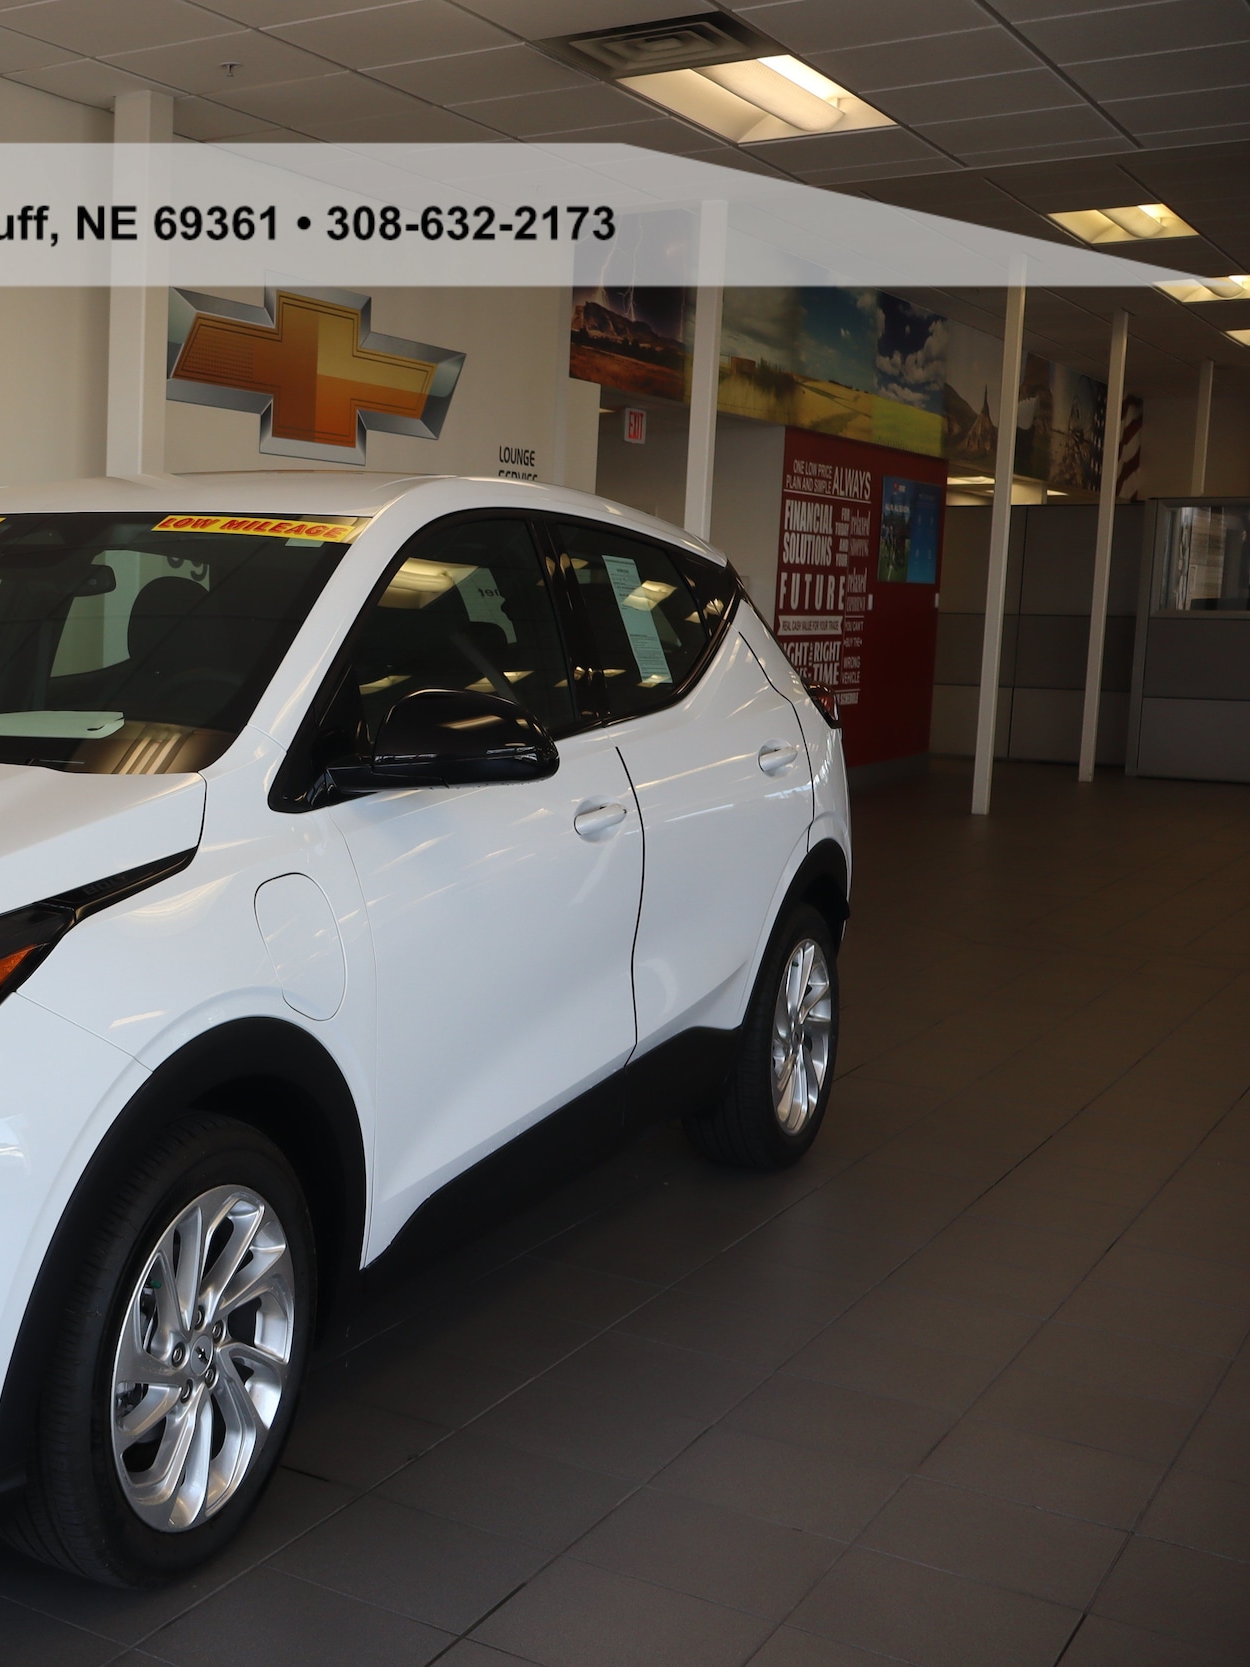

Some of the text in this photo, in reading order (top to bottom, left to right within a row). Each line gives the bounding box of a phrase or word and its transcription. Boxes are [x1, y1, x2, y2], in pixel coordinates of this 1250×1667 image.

[627, 411, 644, 440] EXIT
[499, 446, 536, 467] LOUNGE
[832, 466, 871, 500] ALWAYS
[158, 517, 349, 539] LOW MILEAGE
[783, 499, 833, 534] FINANCIAL
[782, 532, 833, 567] SOLUTIONS
[779, 572, 845, 610] FUTURE
[814, 641, 841, 662] RIGHT
[813, 663, 840, 685] TIME
